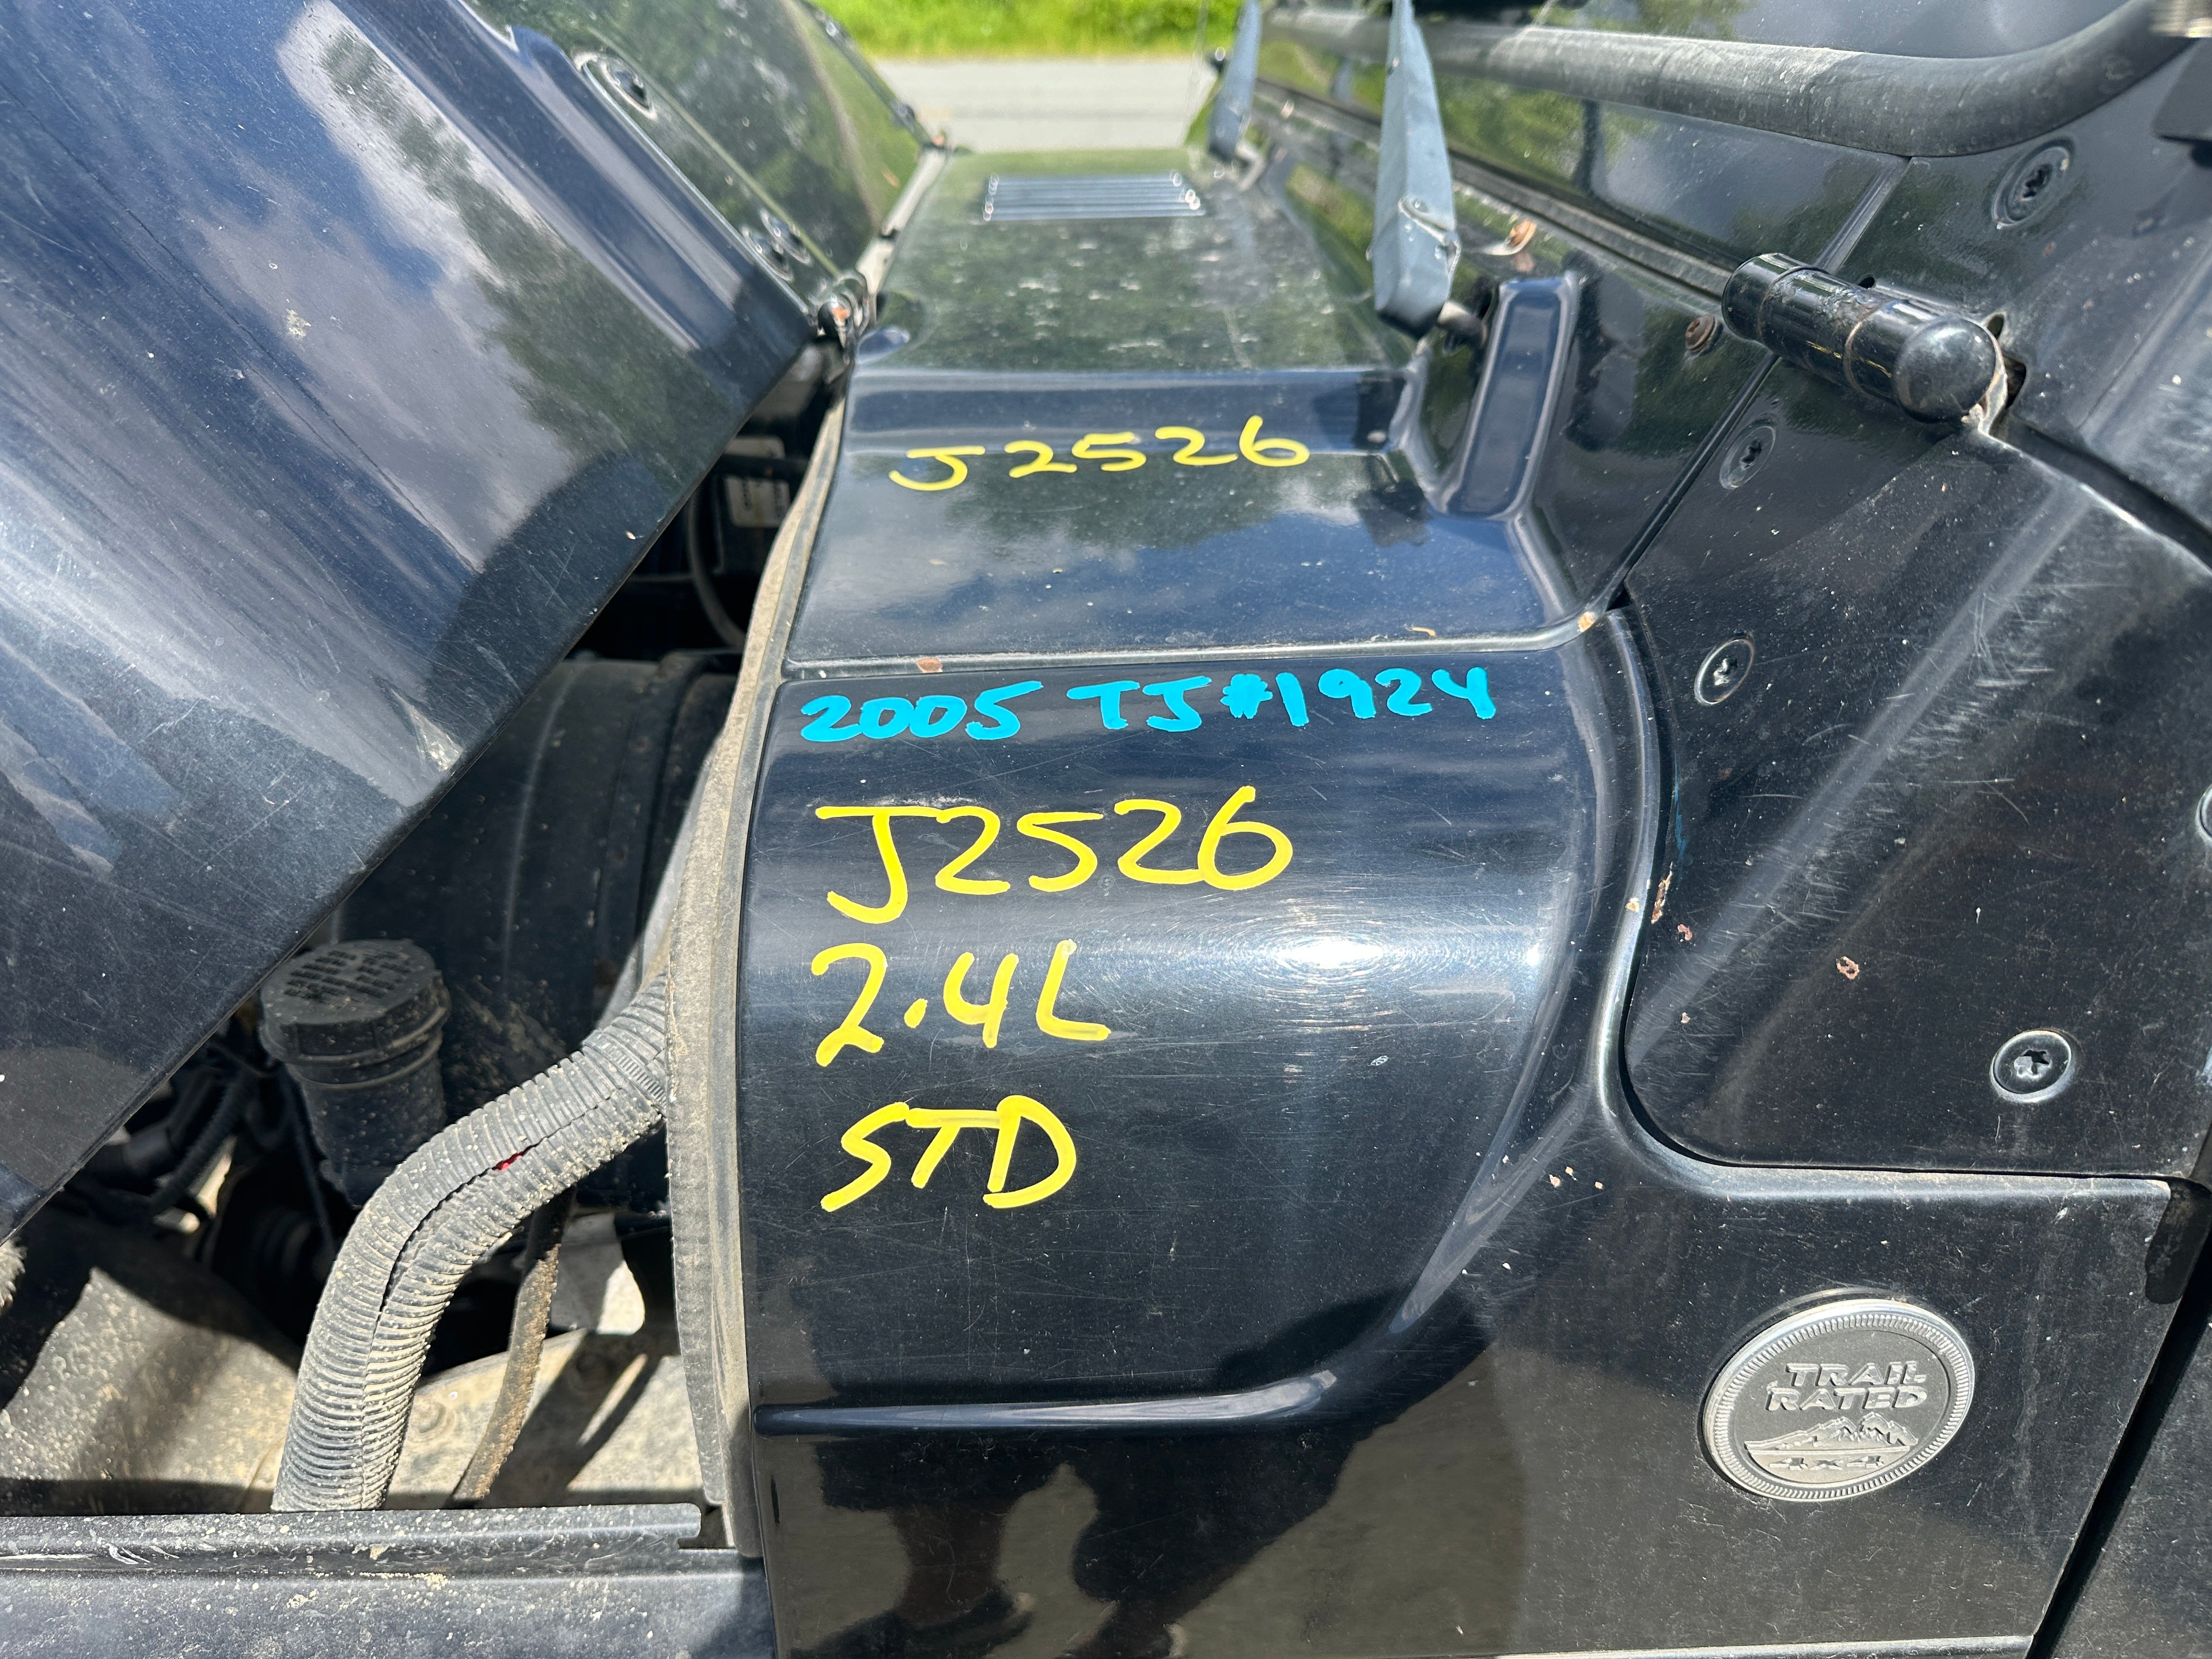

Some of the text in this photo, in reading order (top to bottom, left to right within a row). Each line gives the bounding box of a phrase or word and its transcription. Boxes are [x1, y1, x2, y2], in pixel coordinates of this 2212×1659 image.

[888, 414, 1310, 491] J2526
[800, 679, 1043, 742] 2005
[816, 785, 1293, 924] J2526
[812, 939, 1111, 1067] 2.4L
[821, 1094, 1077, 1211] STD
[1765, 1385, 1927, 1411] RATED
[1786, 1361, 1927, 1387] TRAIL
